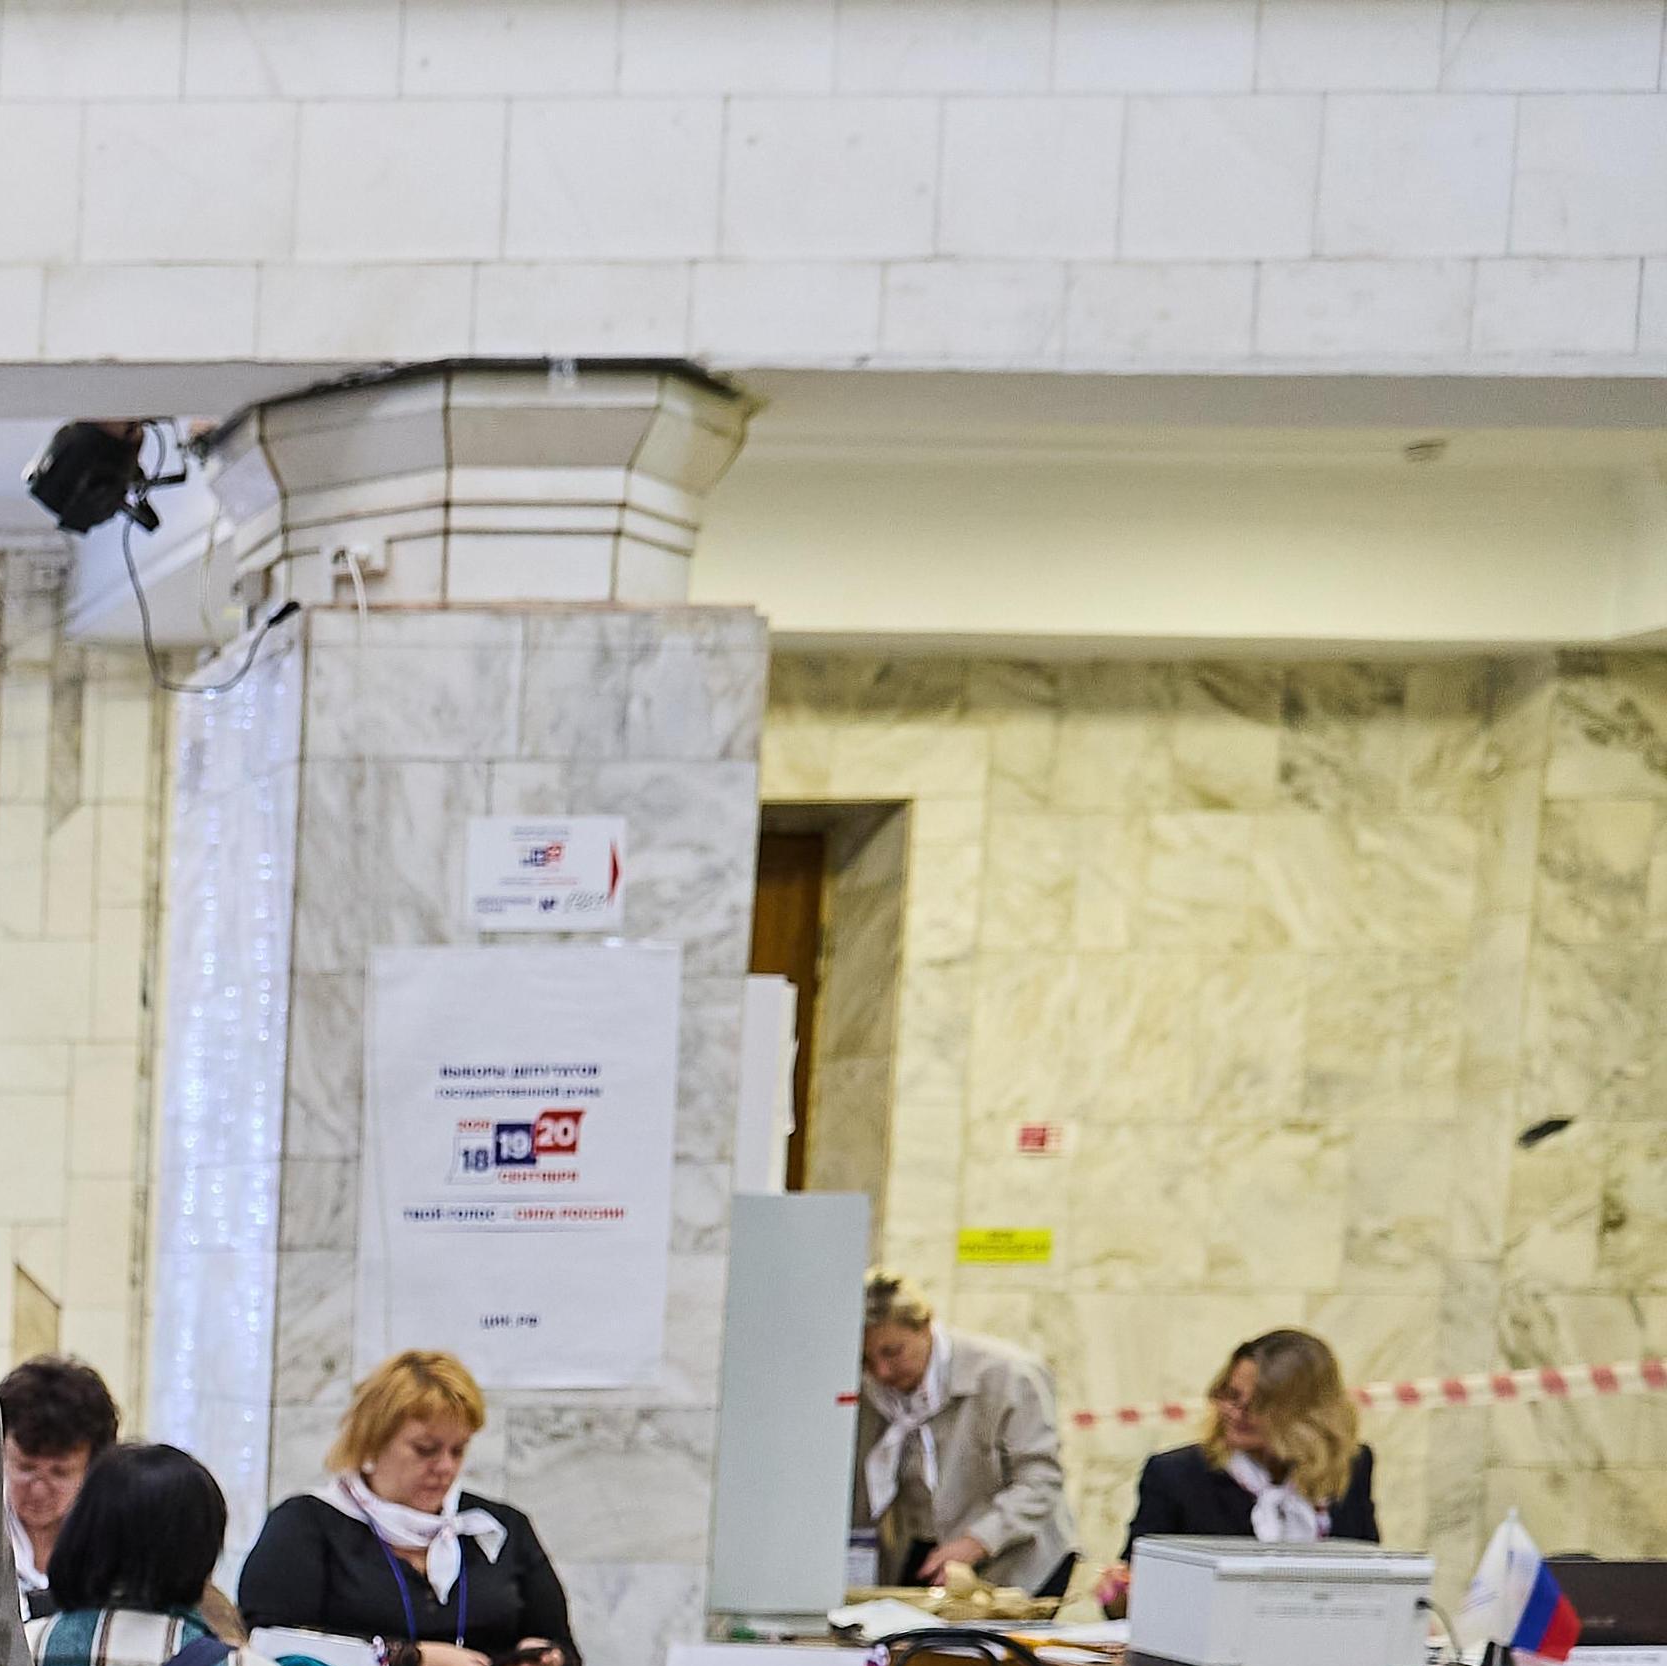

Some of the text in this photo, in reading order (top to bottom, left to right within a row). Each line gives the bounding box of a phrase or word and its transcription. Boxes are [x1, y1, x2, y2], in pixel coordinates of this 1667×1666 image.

[462, 1117, 576, 1172] 18 19 20
